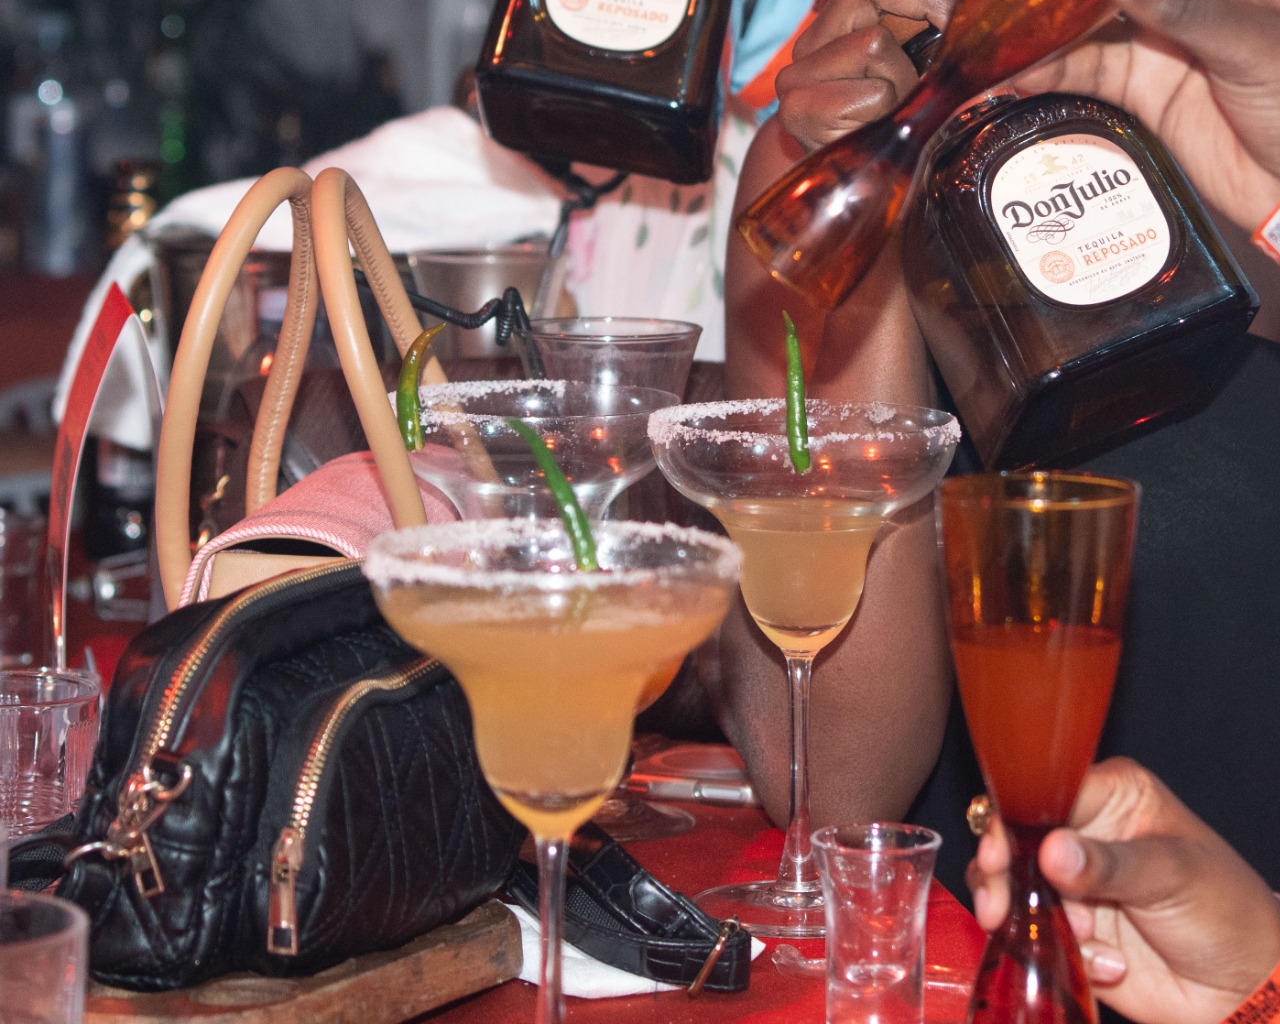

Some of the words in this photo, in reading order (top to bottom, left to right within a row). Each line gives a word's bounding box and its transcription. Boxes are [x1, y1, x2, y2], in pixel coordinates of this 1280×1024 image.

[596, 1, 669, 23] REPOSADO
[1077, 230, 1124, 253] TEQUILA
[1083, 228, 1157, 267] REPOSADO
